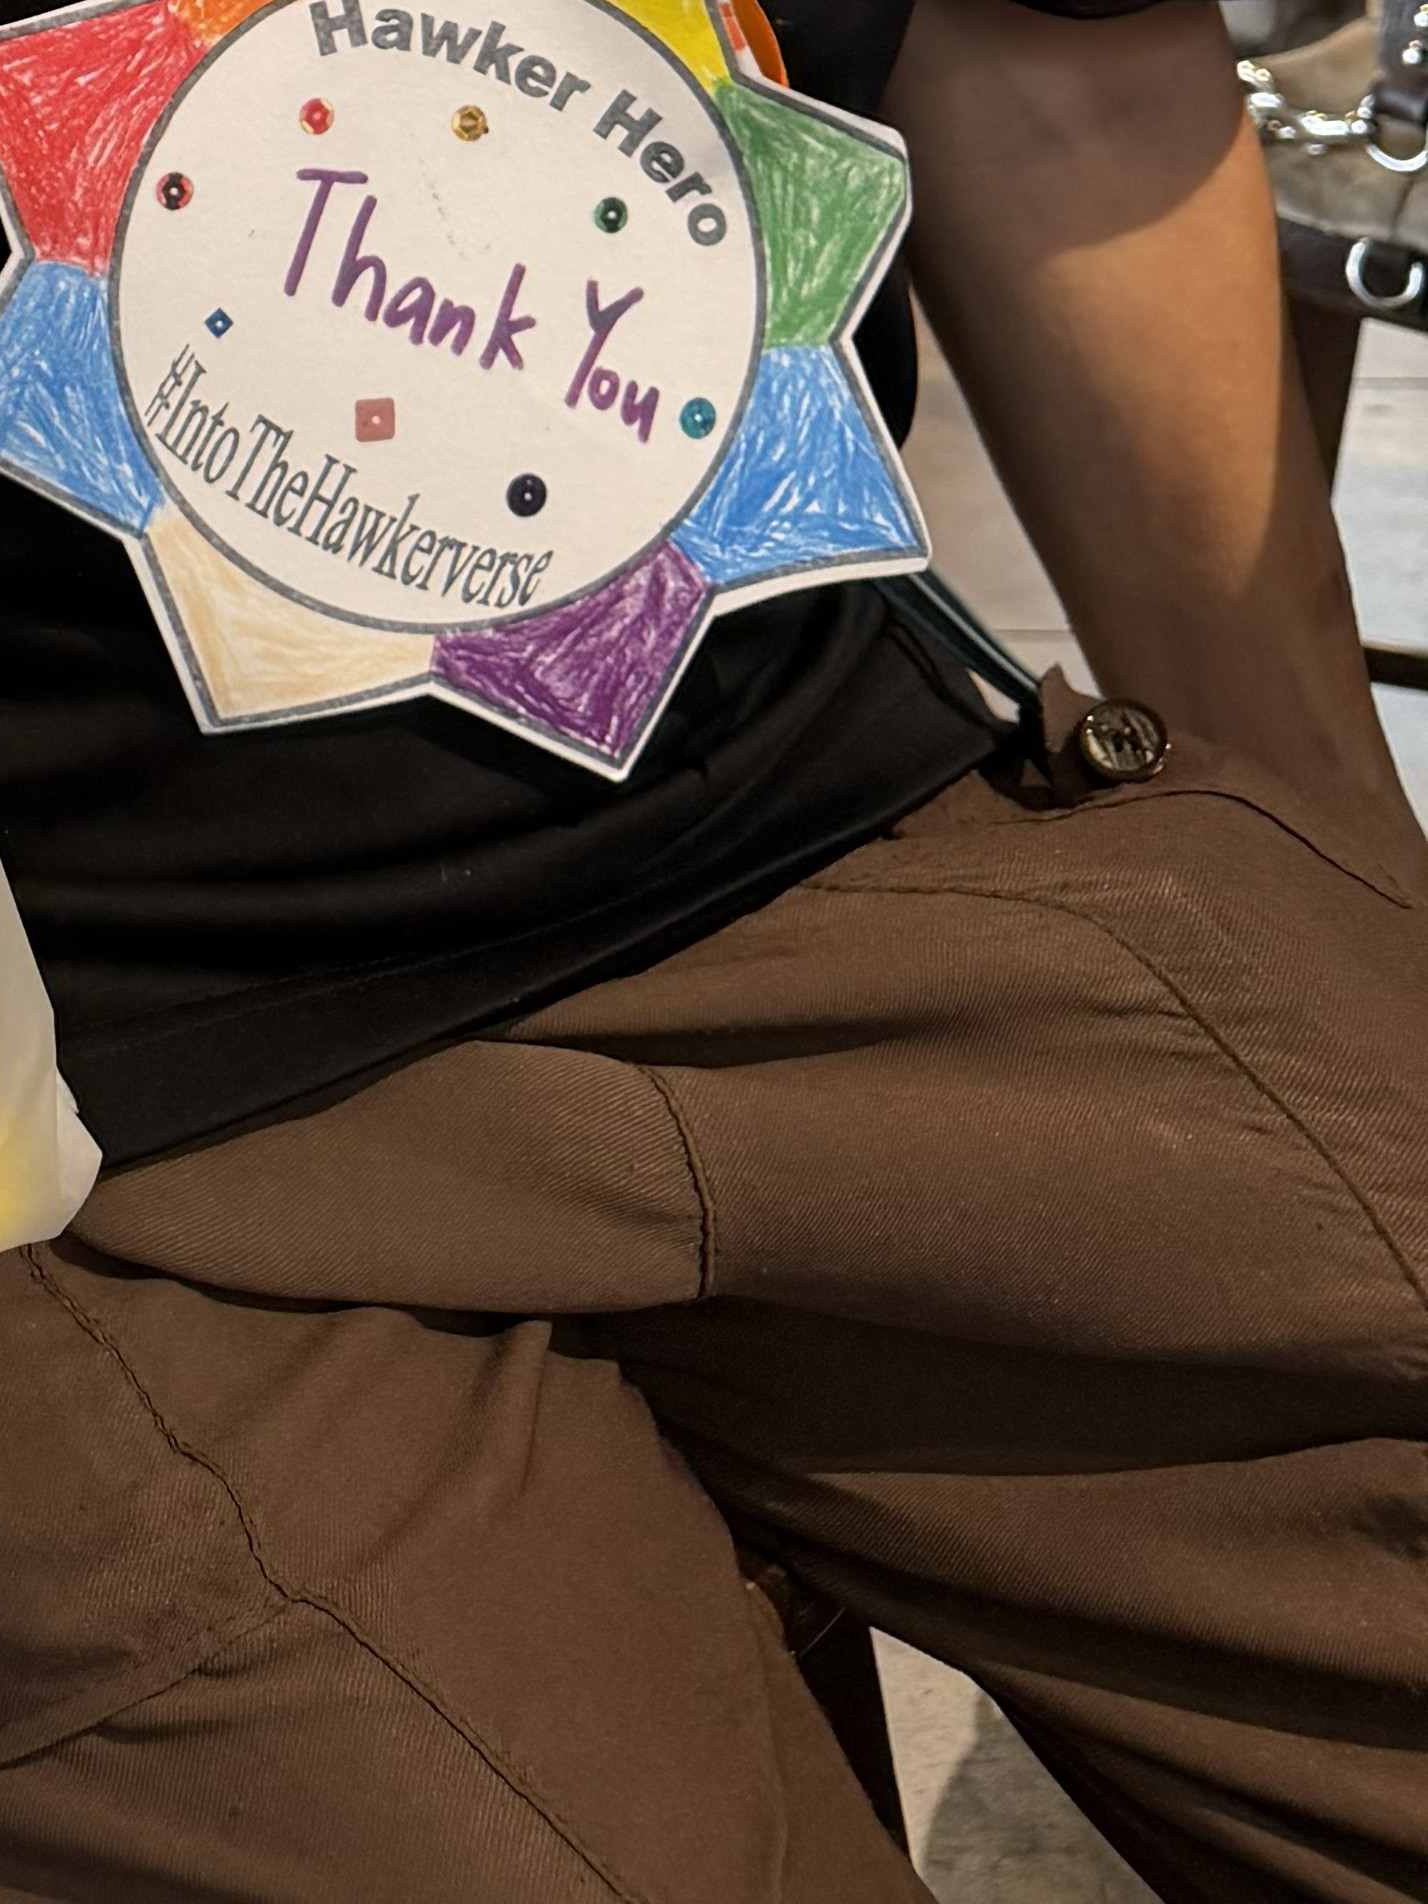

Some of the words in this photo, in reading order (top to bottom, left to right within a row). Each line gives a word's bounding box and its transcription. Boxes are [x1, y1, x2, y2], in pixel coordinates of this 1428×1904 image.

[592, 90, 728, 248] Hero
[283, 168, 536, 372] Thank
[564, 279, 662, 444] You
[143, 343, 553, 609] #IntoTheHawkerverse
